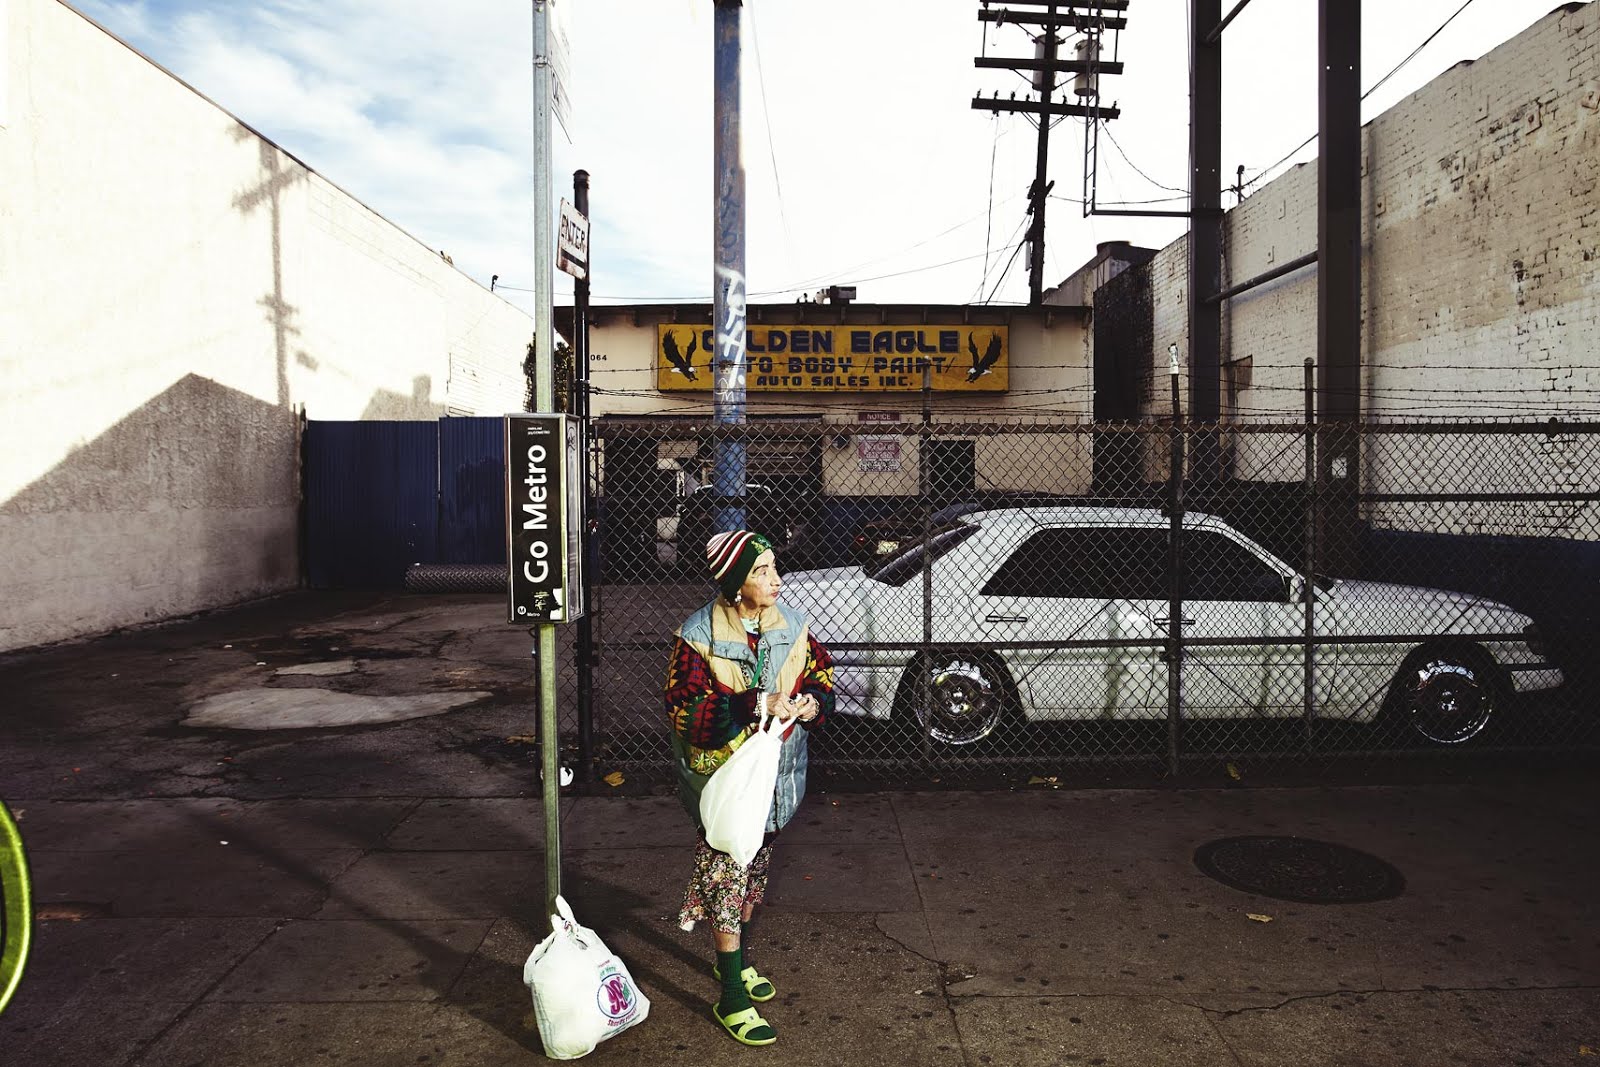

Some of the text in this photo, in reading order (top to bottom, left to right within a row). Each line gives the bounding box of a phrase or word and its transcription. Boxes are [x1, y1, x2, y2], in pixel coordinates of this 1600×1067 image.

[561, 213, 586, 254] ENTER
[702, 330, 960, 353] GLDEN EAGLE
[788, 356, 852, 373] BODY
[757, 376, 914, 387] AUTO SALES INC.
[522, 444, 548, 530] Metro
[523, 540, 549, 583] Go
